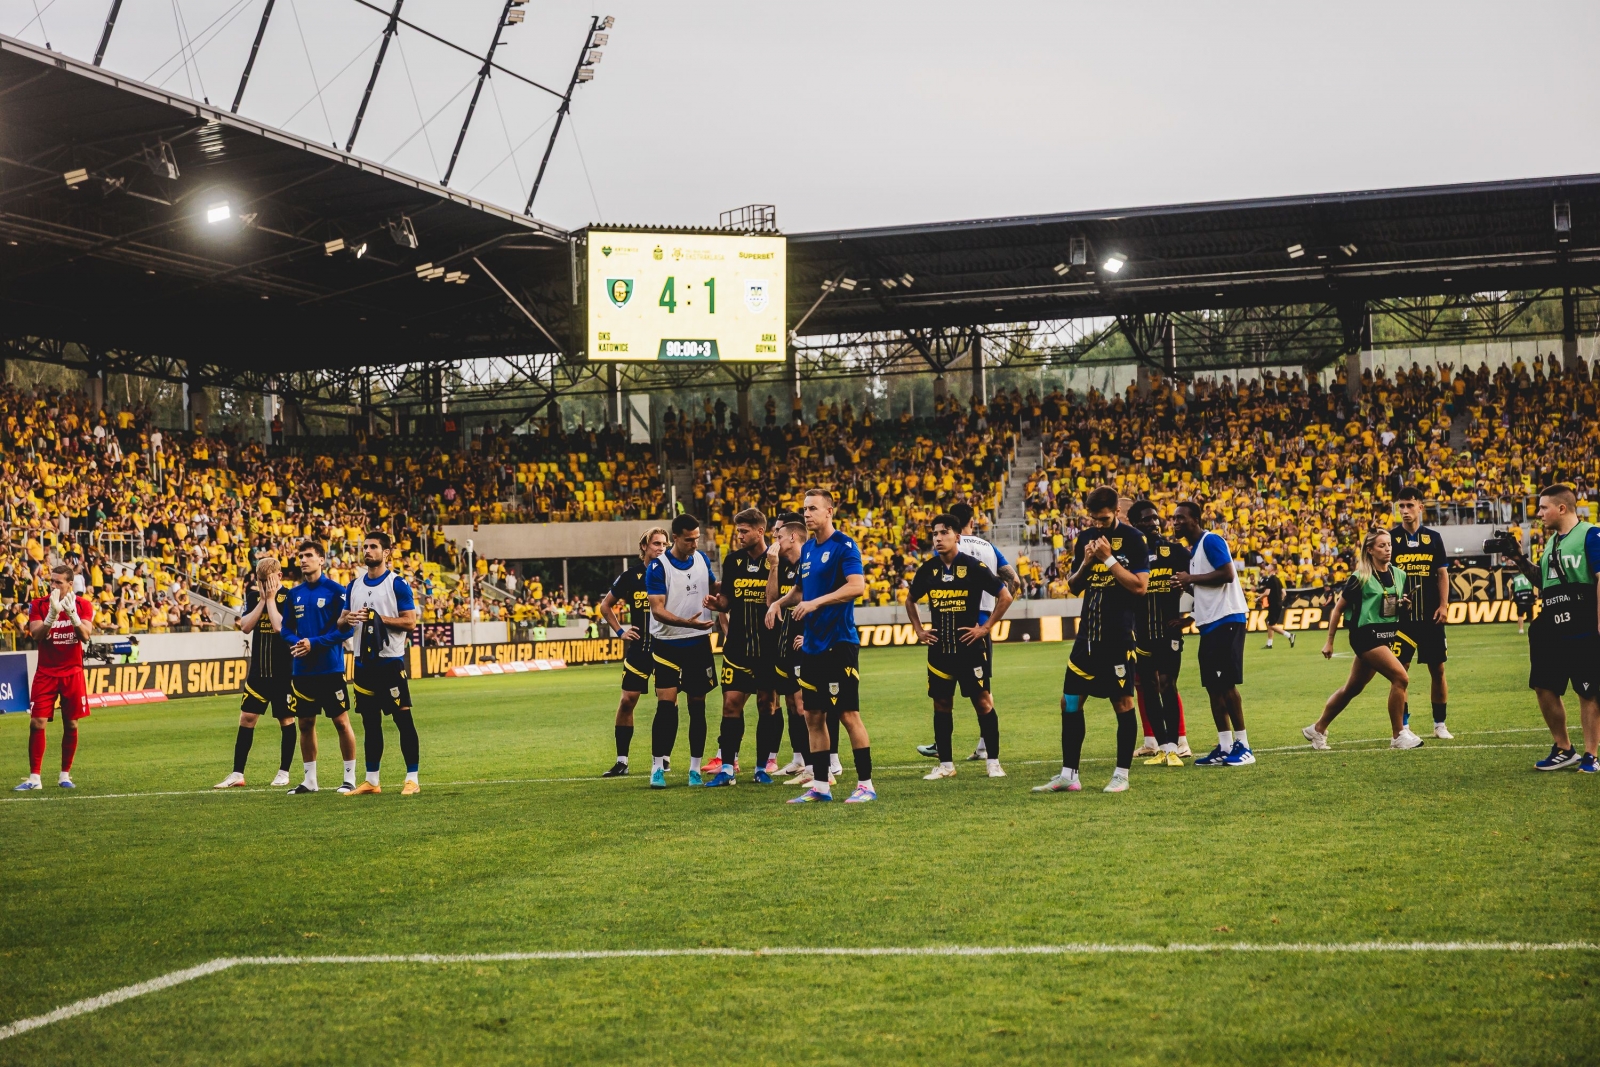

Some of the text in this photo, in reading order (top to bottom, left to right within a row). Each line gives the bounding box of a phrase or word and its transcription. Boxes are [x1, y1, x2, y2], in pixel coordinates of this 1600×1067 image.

[739, 252, 775, 260] SUPERBET
[659, 276, 677, 314] 4
[704, 277, 715, 314] 1
[598, 332, 611, 341] GKS
[761, 334, 777, 342] ARKA
[598, 343, 629, 352] KATOWICE
[755, 344, 777, 353] GDYNIA
[963, 538, 990, 547] macron
[1562, 555, 1582, 569] TV
[1406, 564, 1431, 572] Energa
[1514, 577, 1529, 587] TV
[1554, 611, 1571, 625] 013
[154, 663, 183, 695] NA
[187, 659, 248, 694] SKLEP
